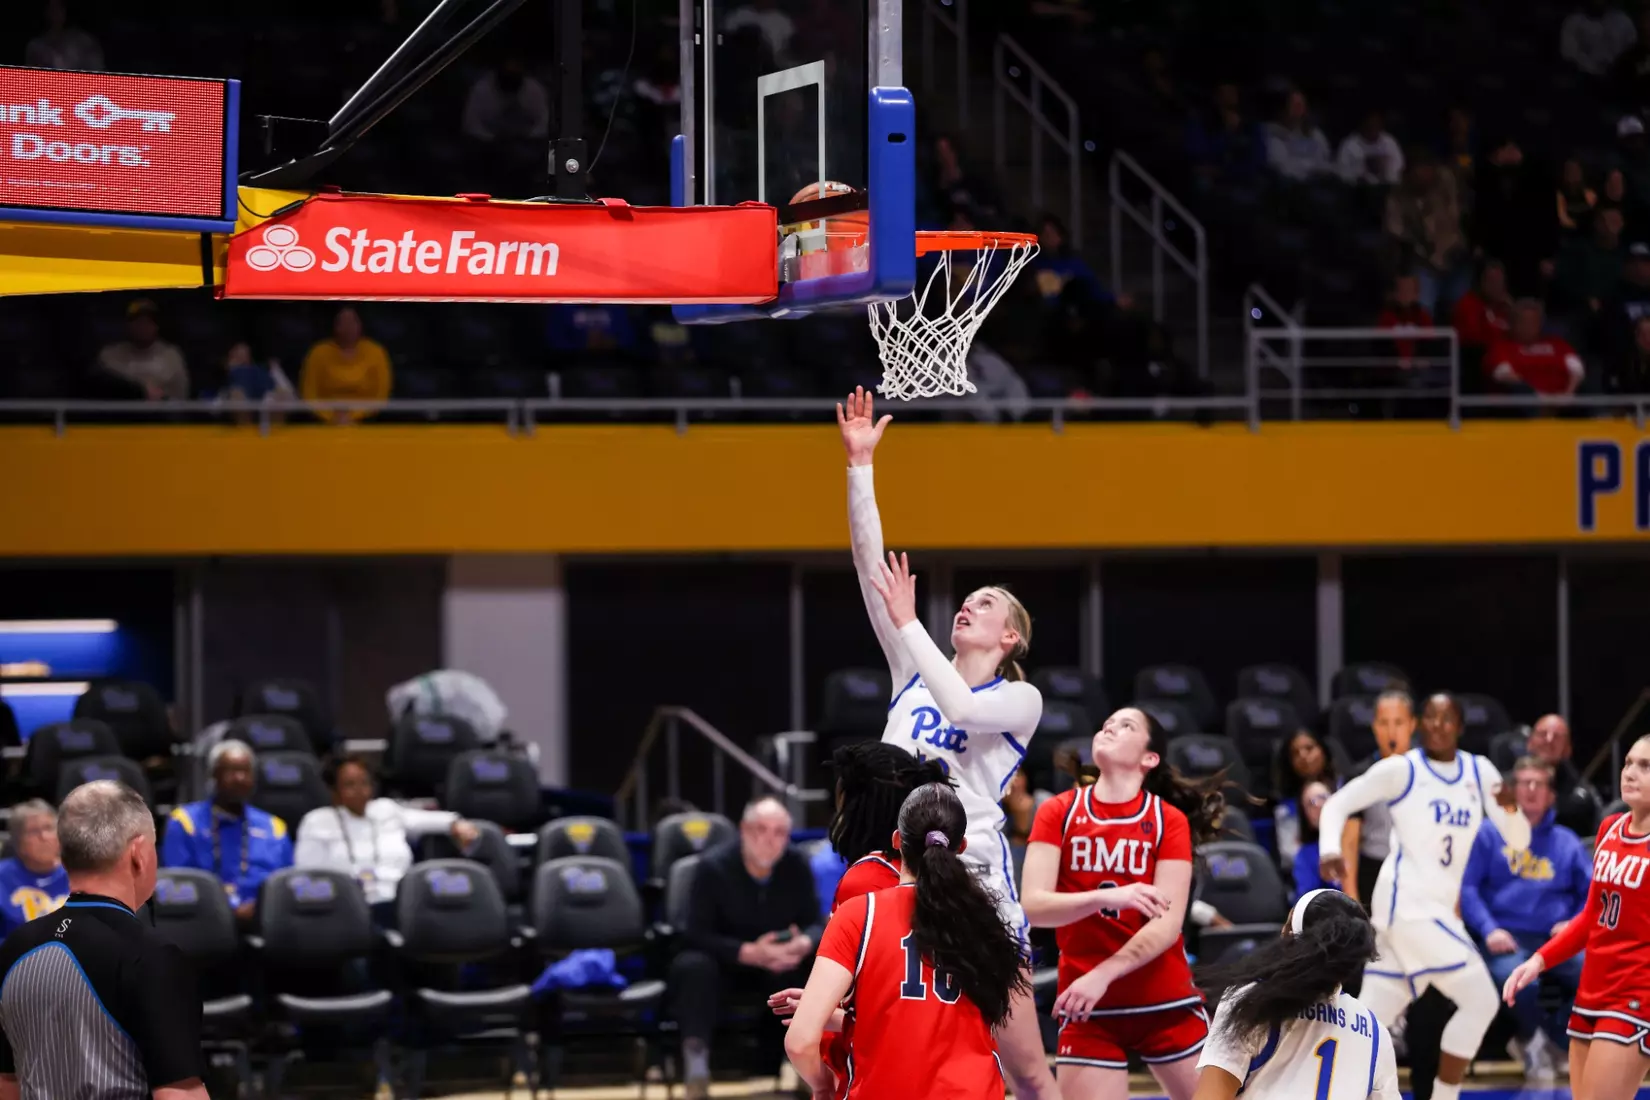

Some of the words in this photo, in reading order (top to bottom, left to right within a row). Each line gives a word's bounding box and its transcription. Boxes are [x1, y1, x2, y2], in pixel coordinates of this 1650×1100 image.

[911, 706, 968, 753] Pitt
[1428, 799, 1471, 827] Pitt
[1070, 835, 1152, 876] RMU
[1439, 834, 1453, 867] 3
[1594, 849, 1650, 889] RMU
[1597, 889, 1622, 931] 10
[1351, 1013, 1372, 1038] JR.
[1313, 1035, 1340, 1100] 1
